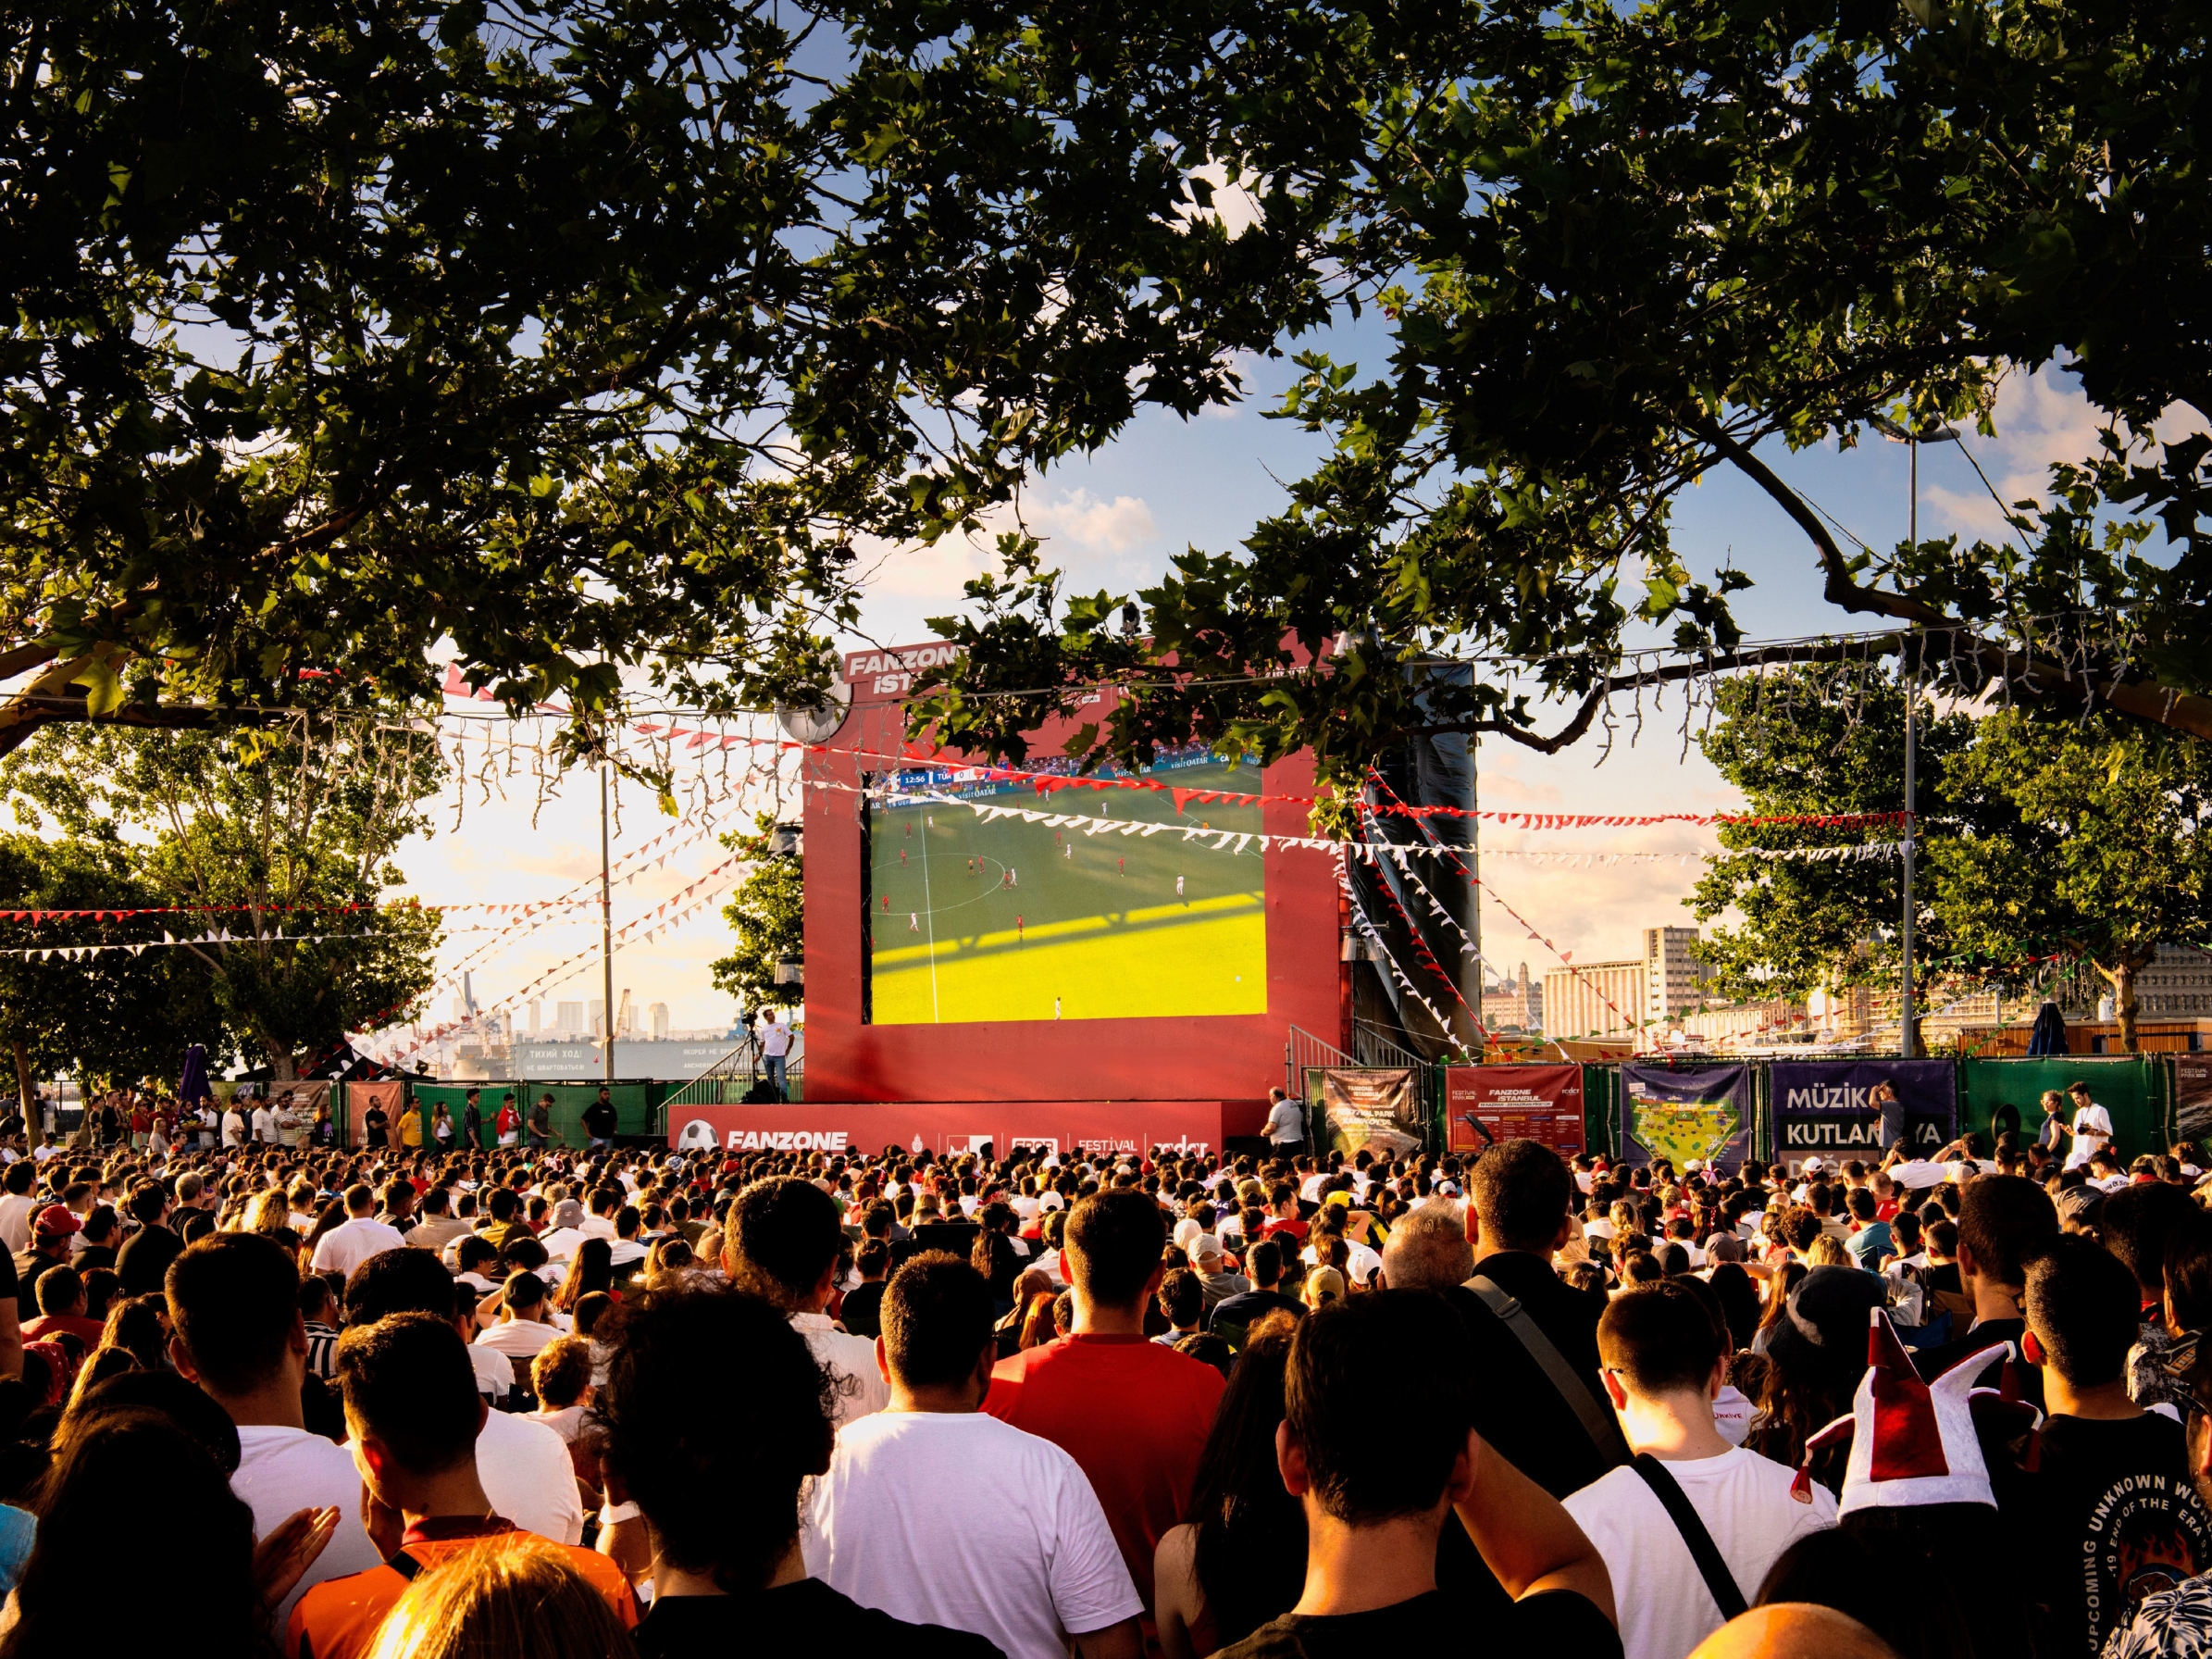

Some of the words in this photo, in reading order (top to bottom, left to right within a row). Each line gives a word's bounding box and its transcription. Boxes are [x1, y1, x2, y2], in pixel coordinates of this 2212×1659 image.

[905, 776, 925, 784] 12:56
[529, 1048, 557, 1059] ТИХИЙ
[562, 1050, 582, 1058] ХОД!
[1787, 1082, 1868, 1109] MÜZİK
[727, 1130, 849, 1151] FANZONE
[1787, 1123, 1942, 1144] KUTLAYA
[1078, 1137, 1137, 1152] FESTİVAL
[2088, 1474, 2166, 1532] UNKNOWN
[2109, 1518, 2122, 1548] END
[2122, 1502, 2135, 1517] OF
[2139, 1498, 2169, 1511] THE
[2178, 1509, 2202, 1537] ERA
[2083, 1540, 2100, 1652] UPCOMING
